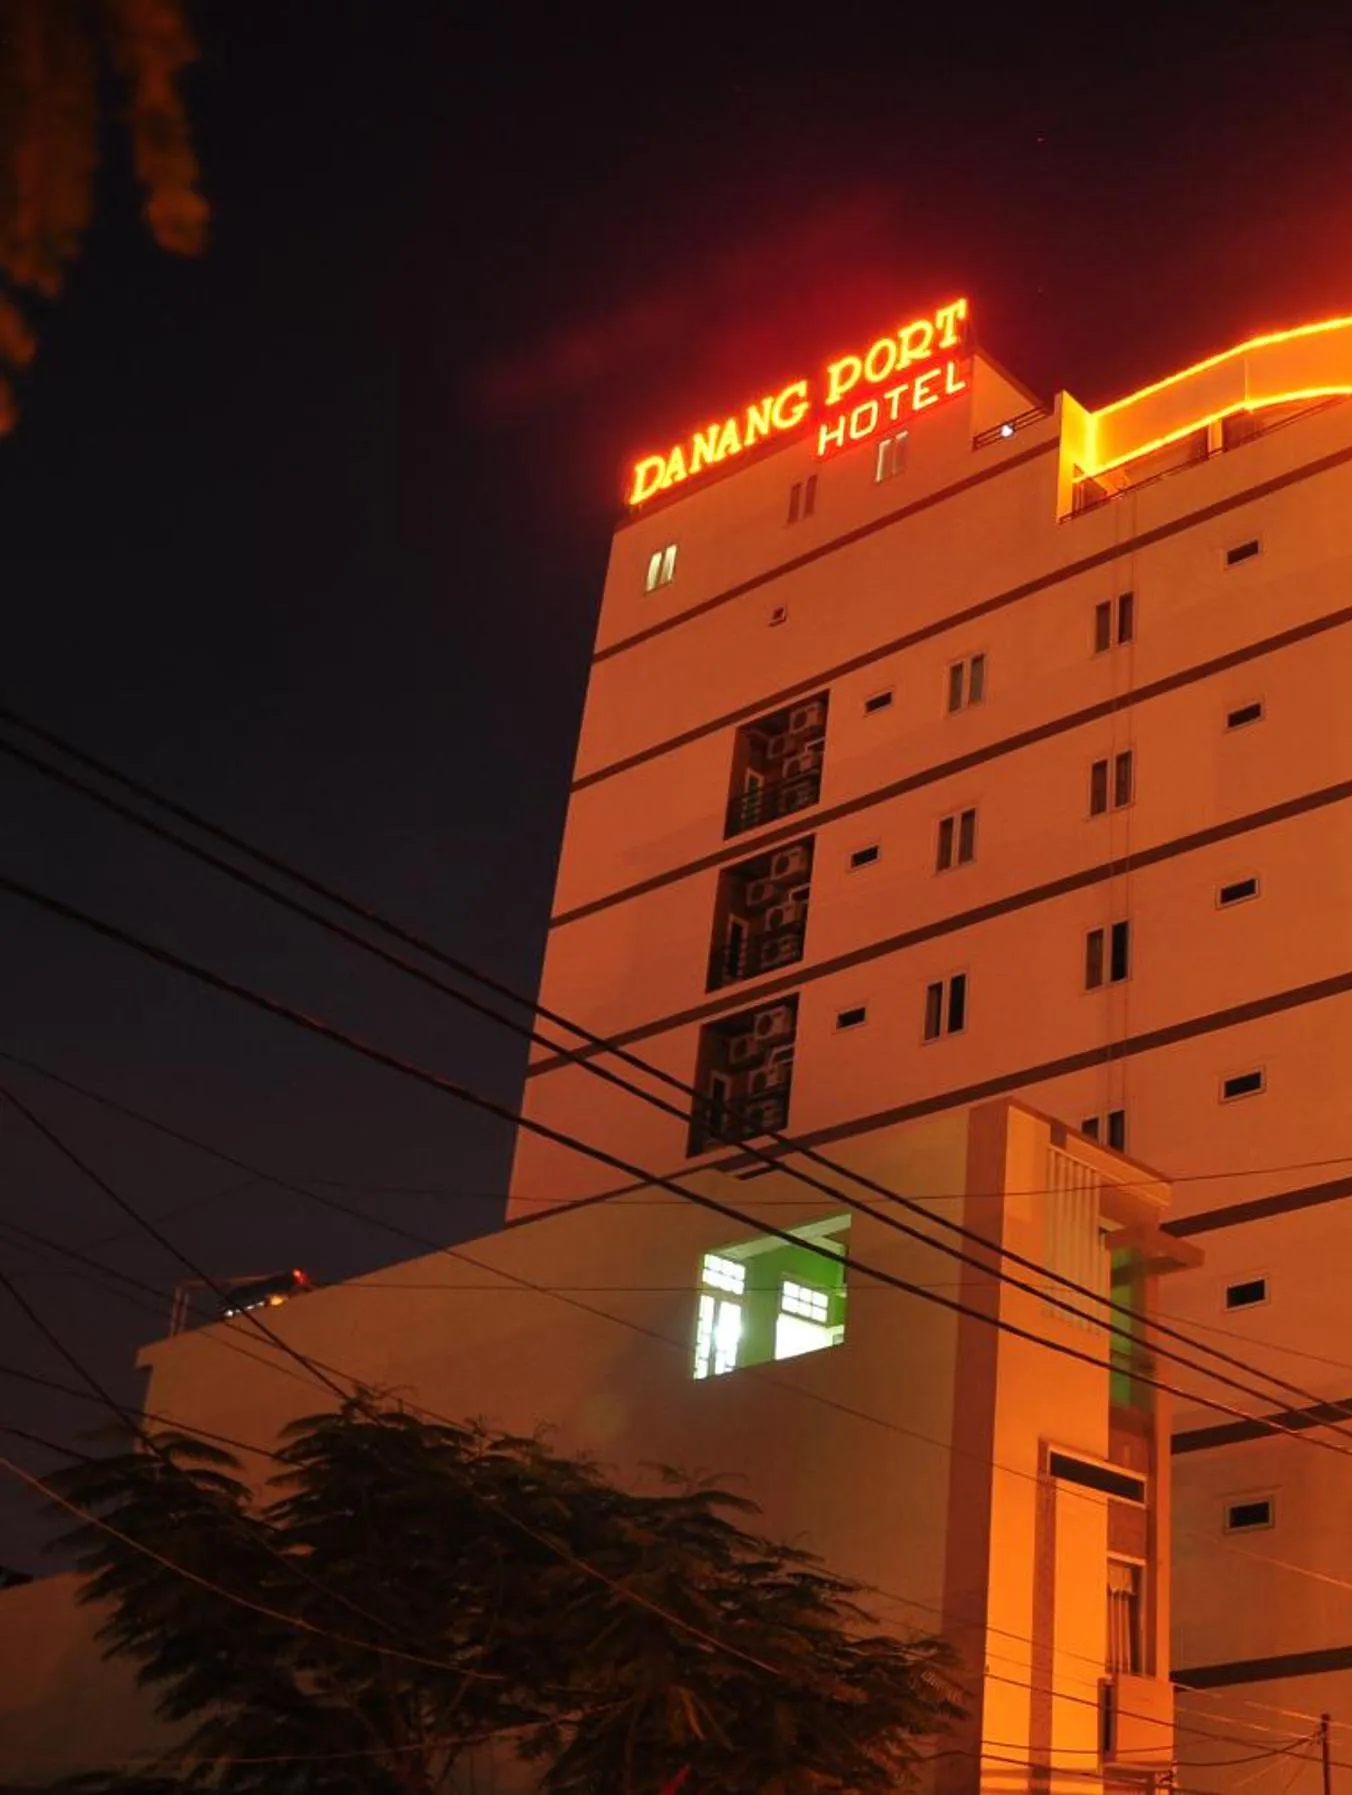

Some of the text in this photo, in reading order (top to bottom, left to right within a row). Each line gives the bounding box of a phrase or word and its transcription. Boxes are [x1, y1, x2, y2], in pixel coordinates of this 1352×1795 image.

[630, 299, 967, 506] DANANG PORT
[818, 363, 967, 456] HOTEL
